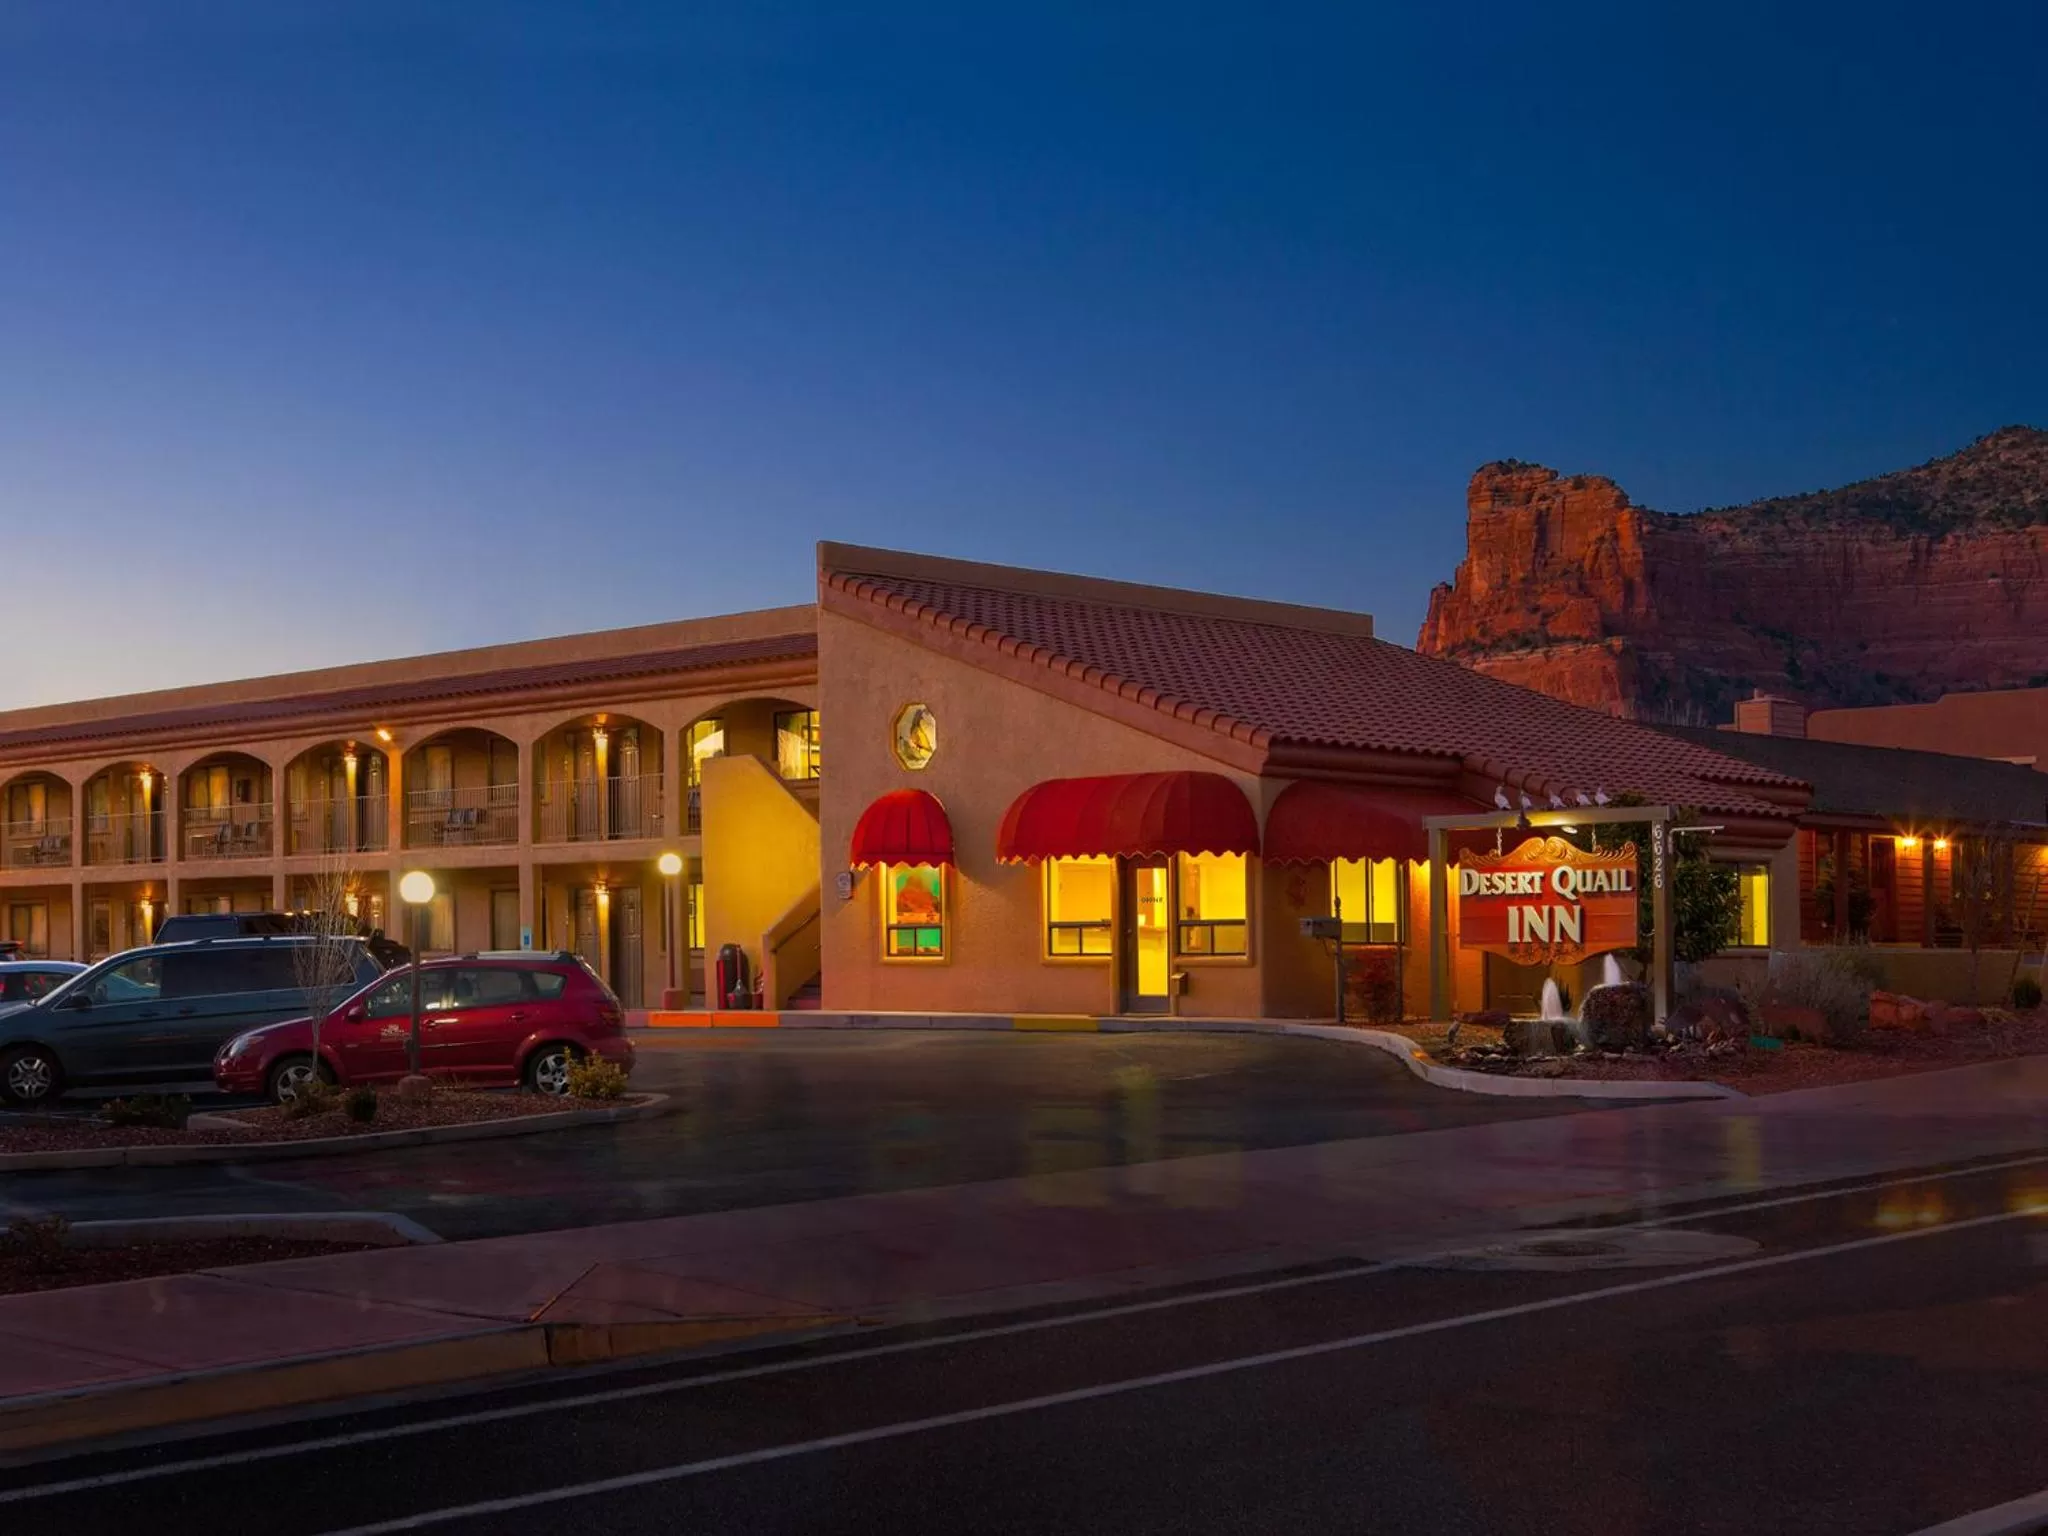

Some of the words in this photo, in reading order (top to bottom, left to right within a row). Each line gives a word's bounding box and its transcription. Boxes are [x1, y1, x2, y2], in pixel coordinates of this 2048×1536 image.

[1654, 824, 1663, 888] 6626
[1460, 868, 1545, 896] DESERT
[1551, 865, 1633, 900] QUAIL
[1507, 905, 1581, 943] INN
